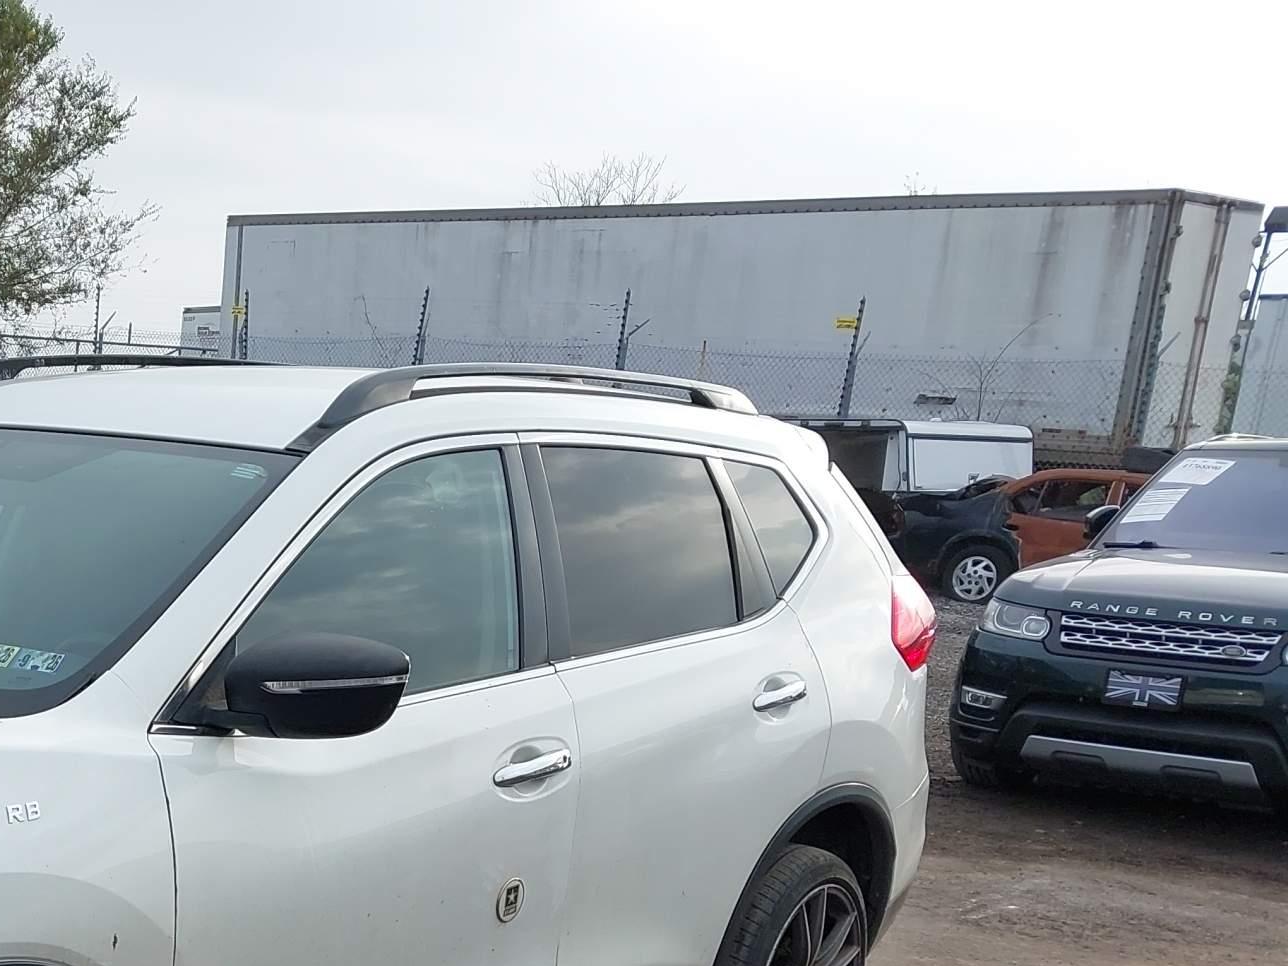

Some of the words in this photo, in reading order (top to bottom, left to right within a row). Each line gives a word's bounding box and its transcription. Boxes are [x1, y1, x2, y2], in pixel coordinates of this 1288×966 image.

[1070, 600, 1159, 617] RANGE
[1177, 610, 1278, 626] ROVER
[5, 801, 41, 825] RB
